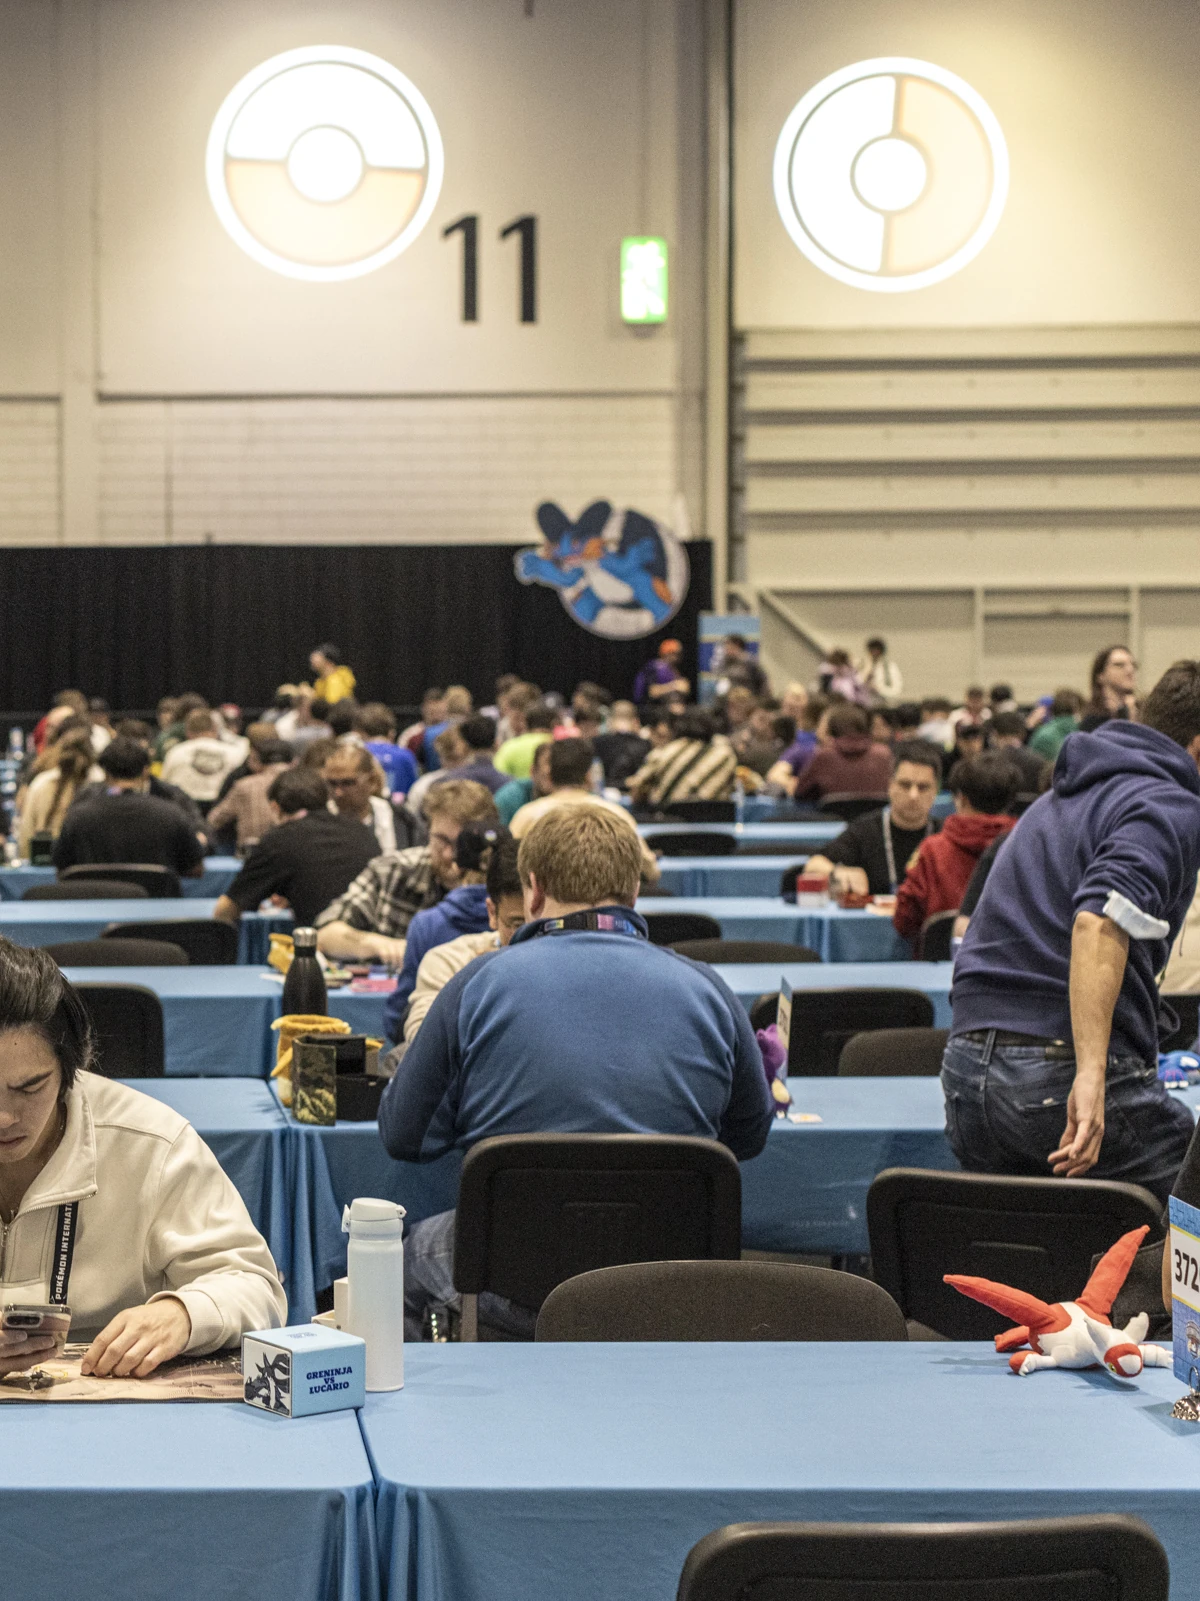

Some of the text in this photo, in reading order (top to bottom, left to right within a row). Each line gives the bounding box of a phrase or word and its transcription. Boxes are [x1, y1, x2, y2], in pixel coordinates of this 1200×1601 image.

[441, 213, 537, 323] 11
[55, 1254, 68, 1300] POKÉMON
[1174, 1248, 1200, 1293] 372
[306, 1366, 353, 1380] GRENINJA
[324, 1377, 335, 1385] VS
[309, 1381, 350, 1395] LUCARIO
